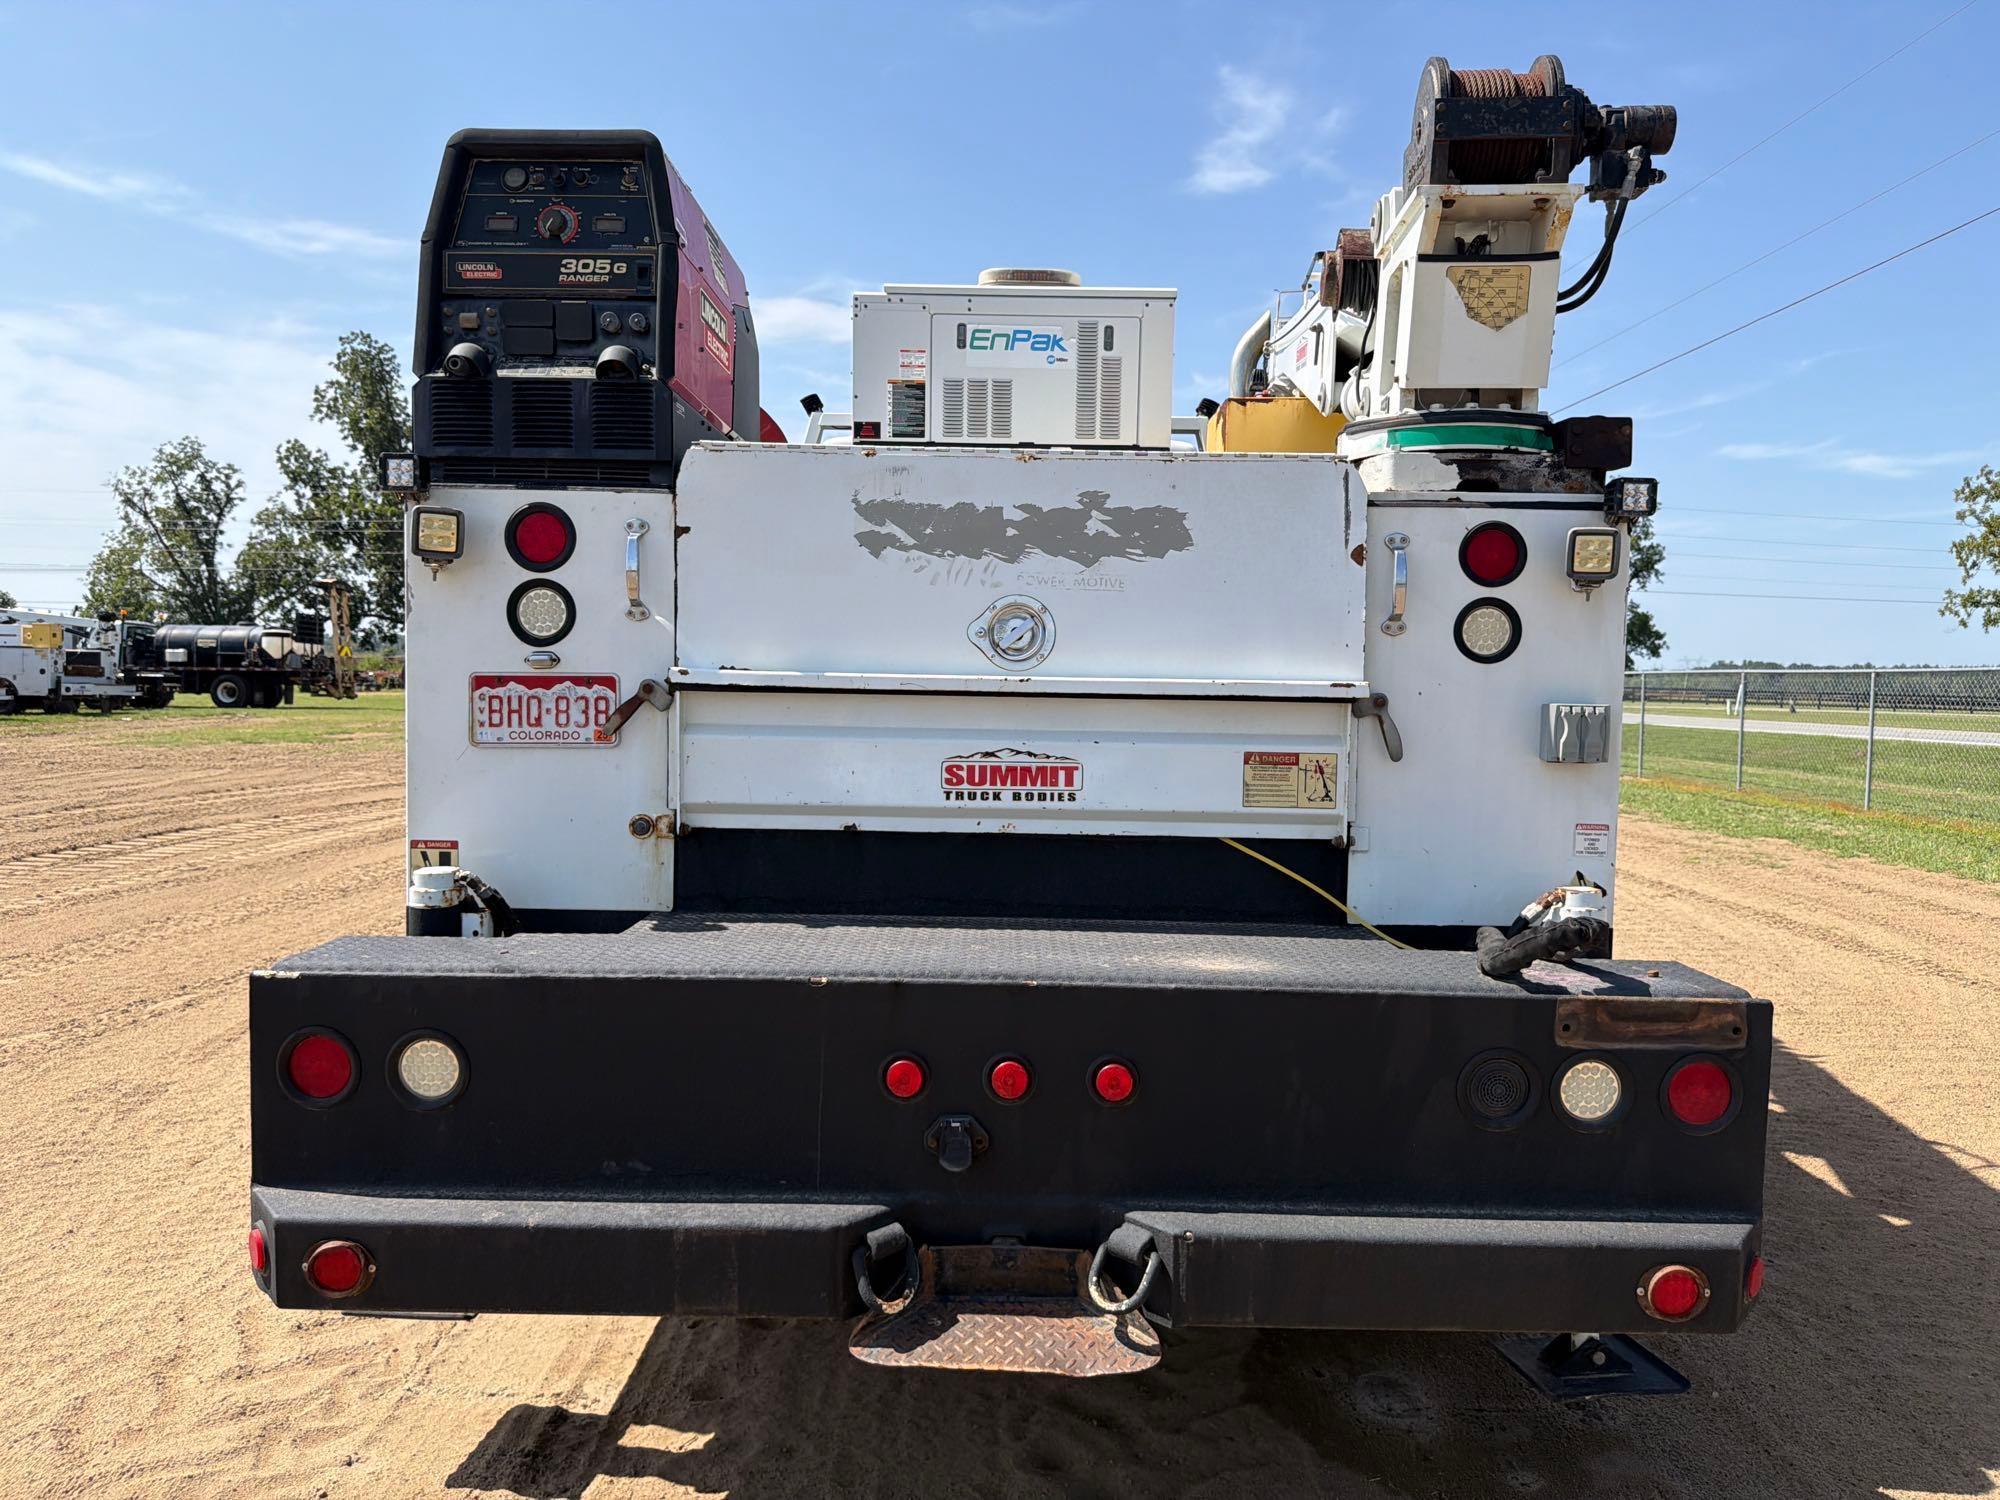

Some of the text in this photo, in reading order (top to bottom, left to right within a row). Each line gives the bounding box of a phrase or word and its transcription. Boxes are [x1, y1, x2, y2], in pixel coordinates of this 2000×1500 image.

[458, 263, 494, 271] LINCOLN
[701, 293, 727, 343] LINCOLN
[707, 330, 729, 367] ELECTRIC
[969, 328, 1068, 352] EnPak
[508, 730, 580, 741] COLORADO
[1262, 755, 1296, 763] DANGER
[943, 764, 1079, 788] SUMMIT
[943, 790, 1077, 802] TRUCK BODIES
